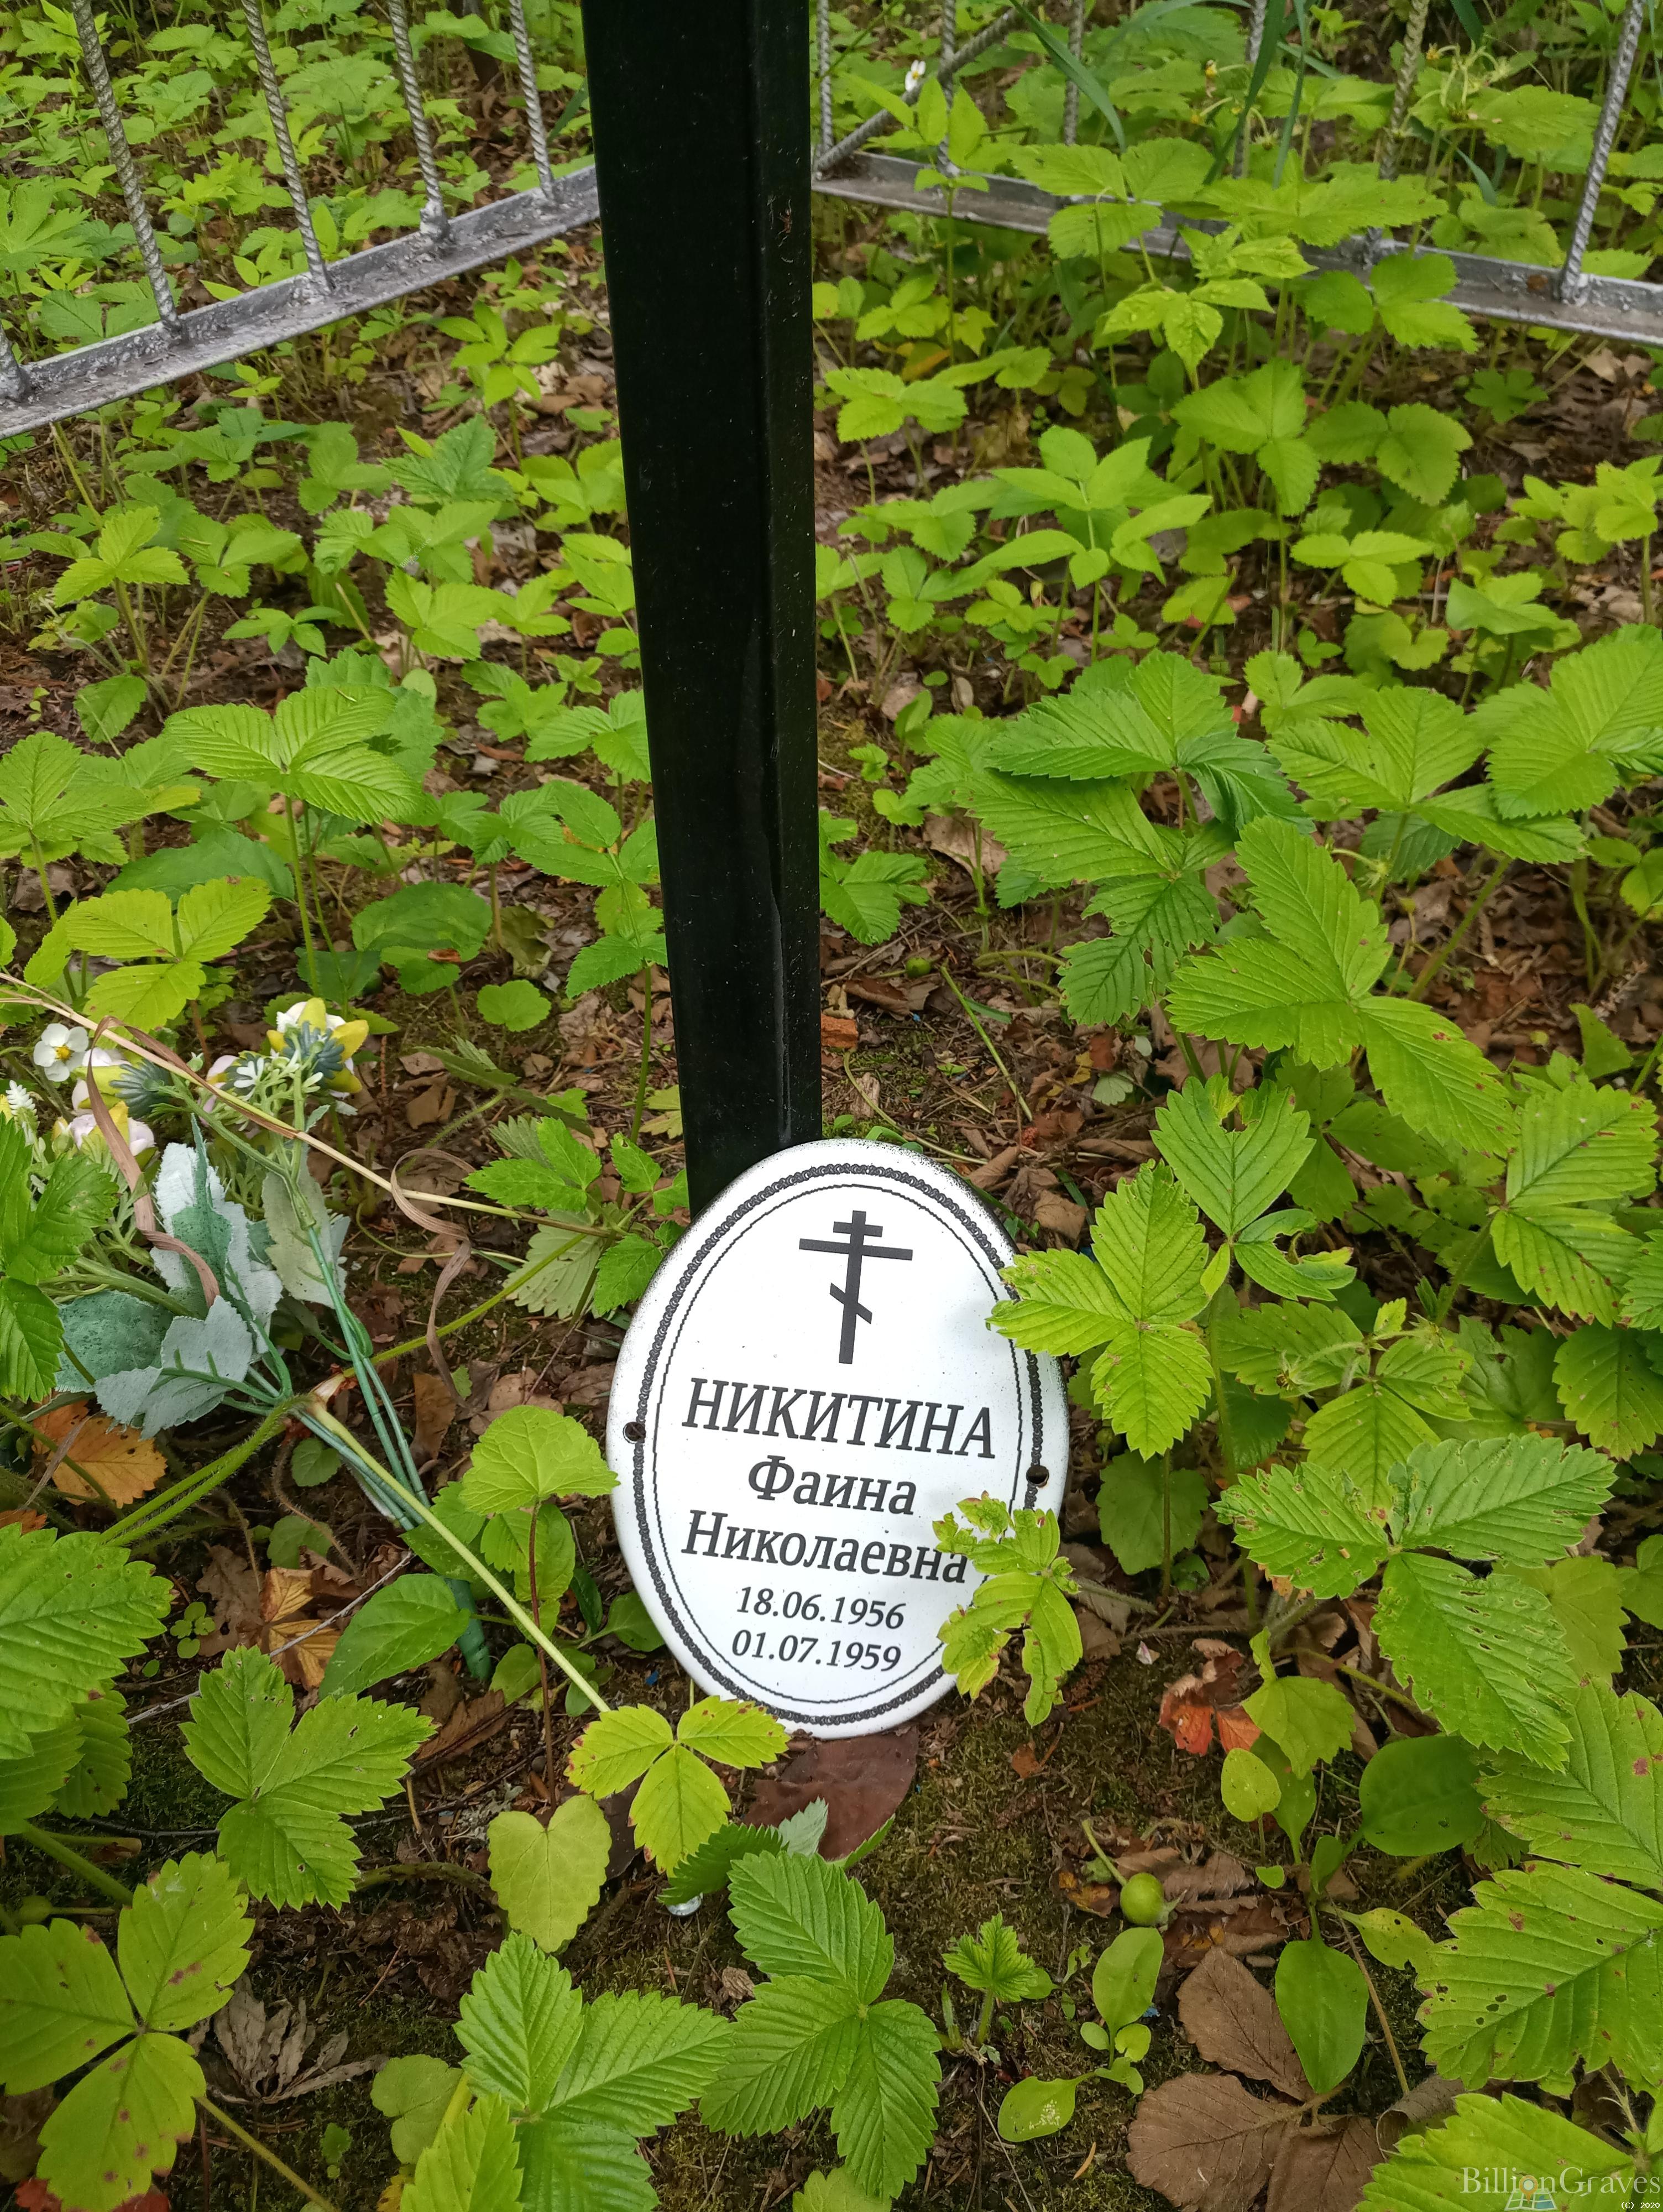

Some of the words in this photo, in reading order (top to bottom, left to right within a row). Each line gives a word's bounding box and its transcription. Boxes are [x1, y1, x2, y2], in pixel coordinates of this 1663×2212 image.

[682, 1378, 995, 1458] НИКИТИНА
[748, 1454, 917, 1515] Фаина
[681, 1510, 968, 1583] Николаевна
[736, 1586, 906, 1629] 18.06.1956
[731, 1629, 901, 1672] 01.07.1959
